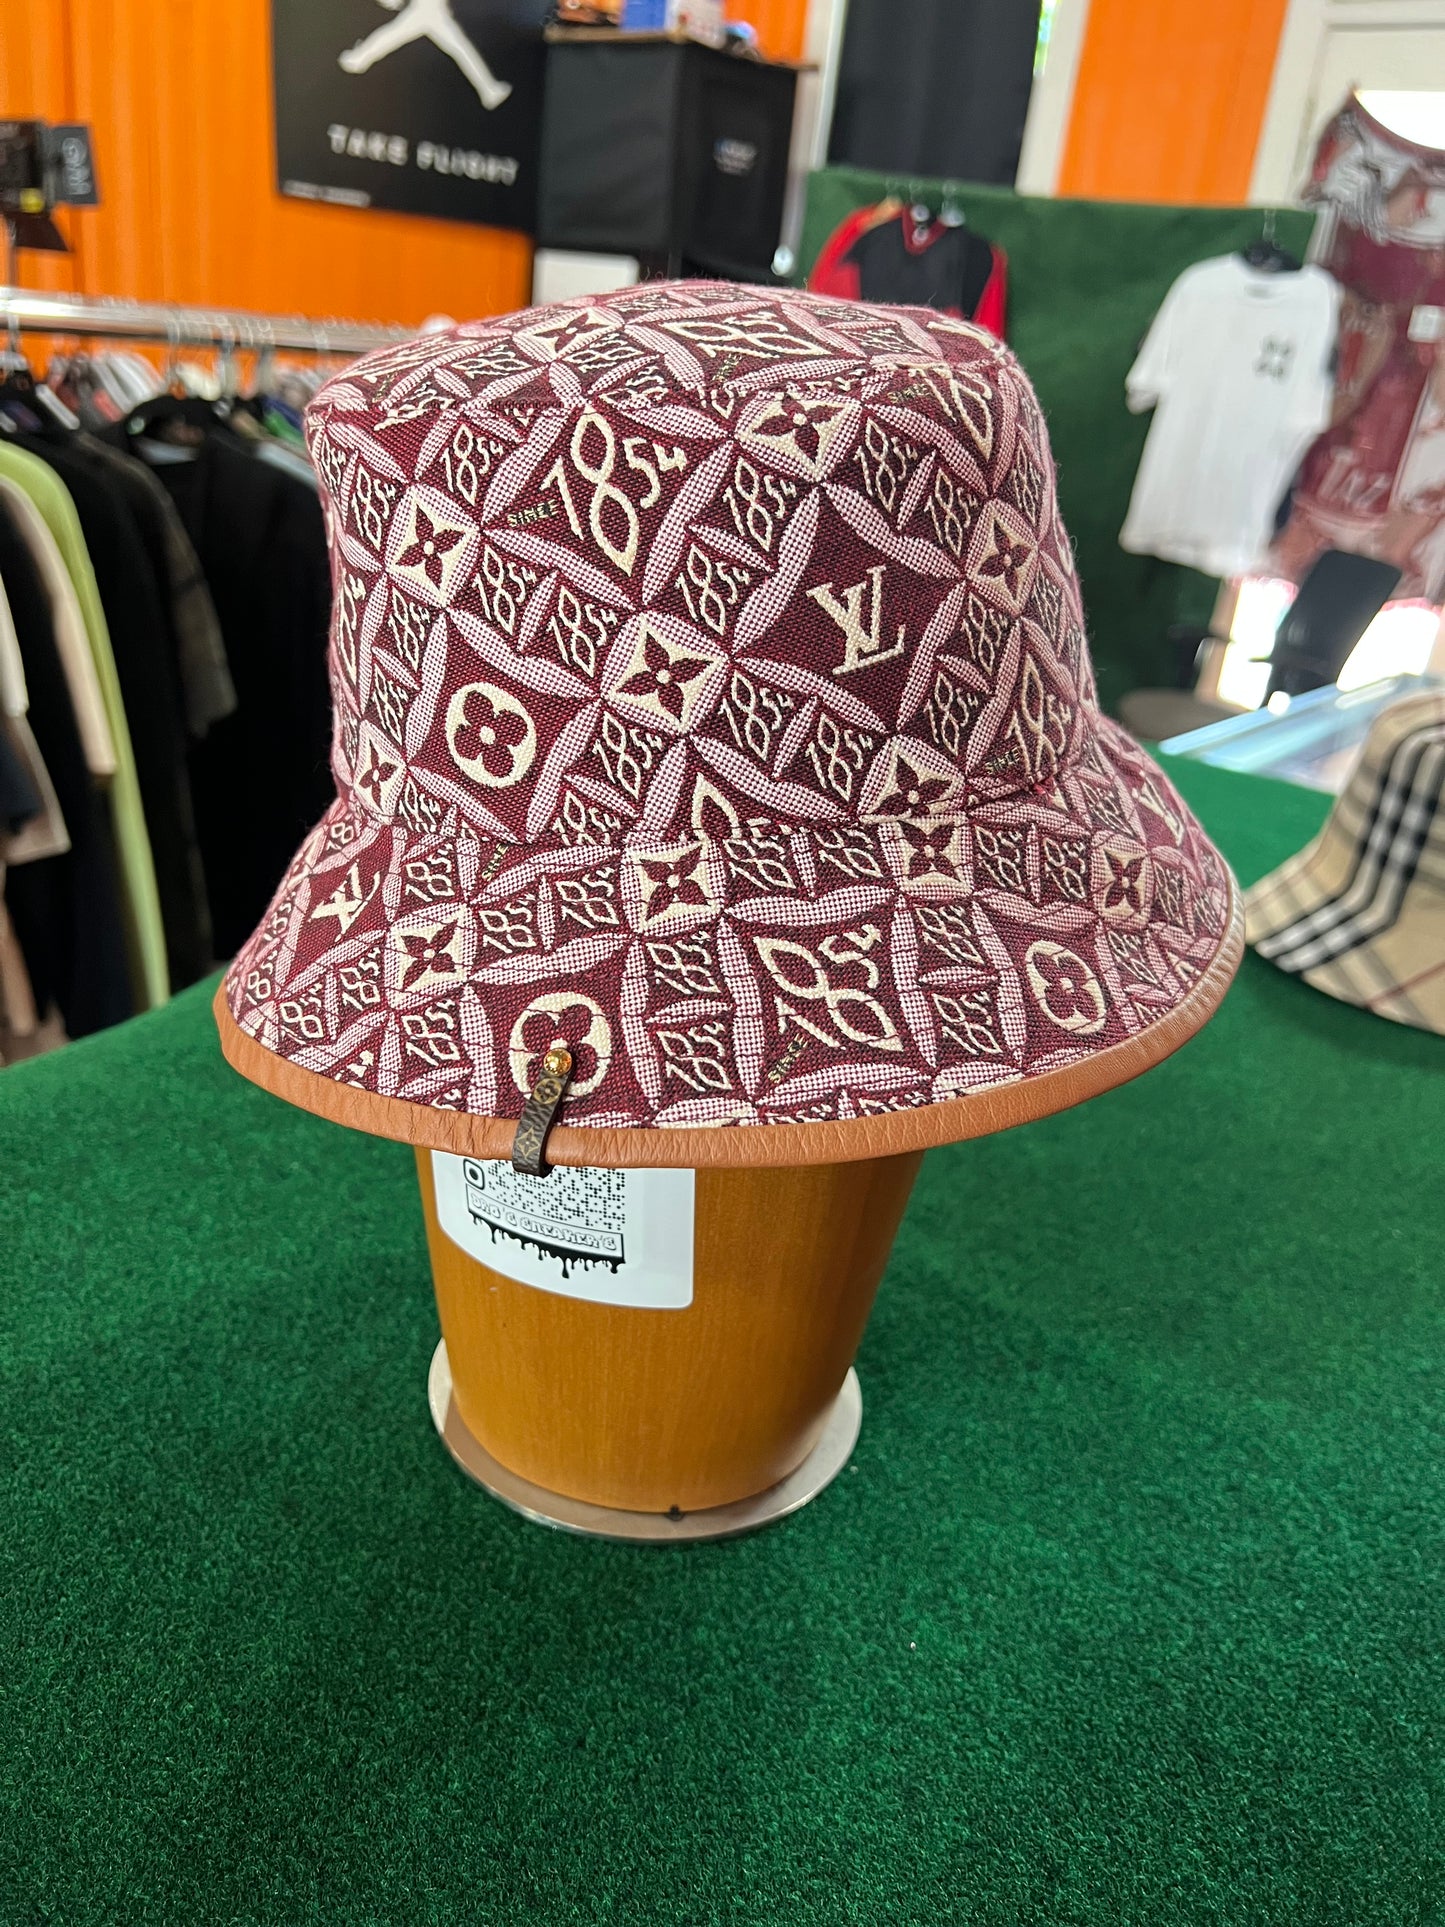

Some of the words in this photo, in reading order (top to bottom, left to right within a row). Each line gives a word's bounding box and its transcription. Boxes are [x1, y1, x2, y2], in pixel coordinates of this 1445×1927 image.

[327, 123, 409, 166] TAKE
[416, 140, 519, 186] FLIGHT
[352, 463, 397, 551] 1854
[440, 423, 504, 507] 1854
[539, 406, 688, 577] 1854
[723, 456, 798, 552] 1854
[852, 416, 919, 513] 1854
[923, 467, 979, 560] 1854
[388, 585, 432, 672] 1854
[474, 543, 538, 636] 1854
[547, 584, 619, 678] 1854
[674, 542, 750, 636] 1854
[805, 564, 907, 675] LV
[962, 589, 1010, 677] 1854
[592, 709, 666, 800] 1854
[718, 669, 796, 761] 1854
[806, 712, 873, 801] 1854
[923, 670, 979, 756] 1854
[404, 843, 456, 903] 1854
[555, 866, 621, 929] 1854
[478, 892, 537, 953] 1854
[647, 930, 722, 996] 1854
[913, 904, 986, 966] 1854
[339, 946, 382, 1011] 1854
[752, 922, 904, 1052] 1854
[402, 999, 461, 1067] 1854
[656, 1021, 734, 1092] 1854
[932, 990, 1004, 1056] 1854
